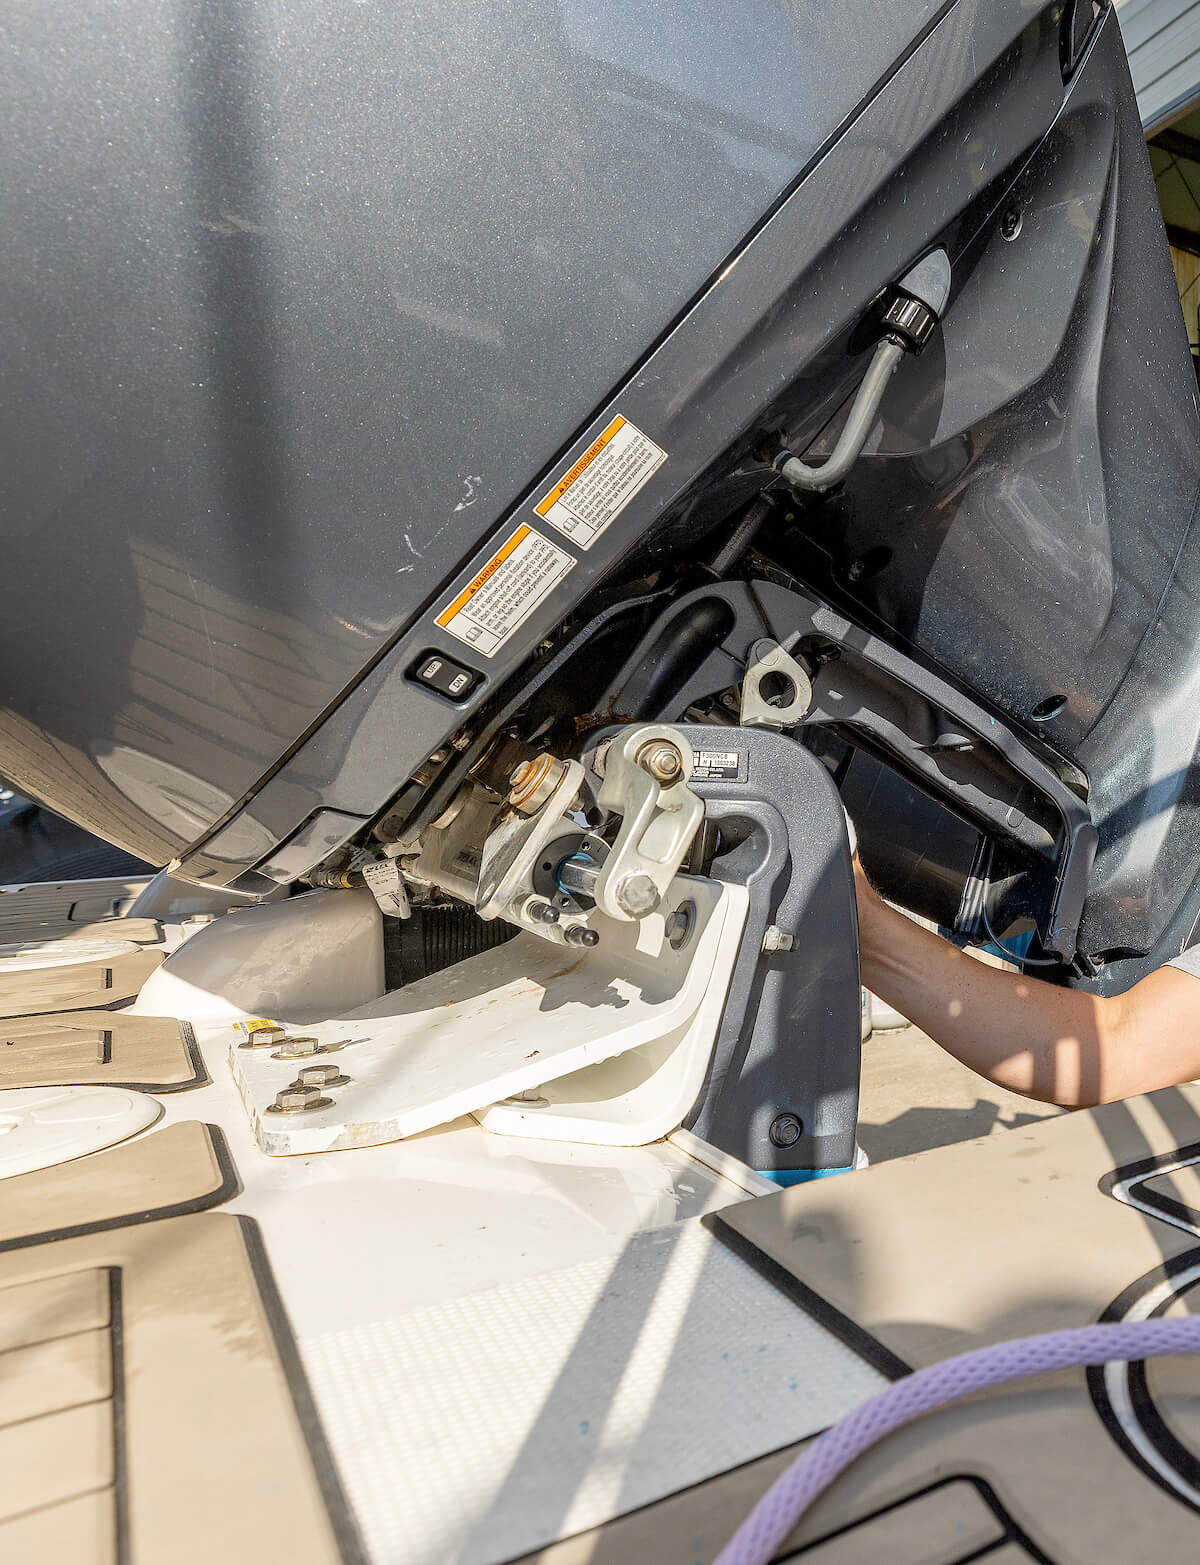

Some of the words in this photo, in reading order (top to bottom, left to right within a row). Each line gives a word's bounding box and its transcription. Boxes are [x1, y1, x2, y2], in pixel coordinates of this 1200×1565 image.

[561, 438, 607, 487] AVERTISSEMENT
[472, 557, 502, 588] WARNING
[427, 664, 437, 674] UP
[452, 677, 464, 689] DN
